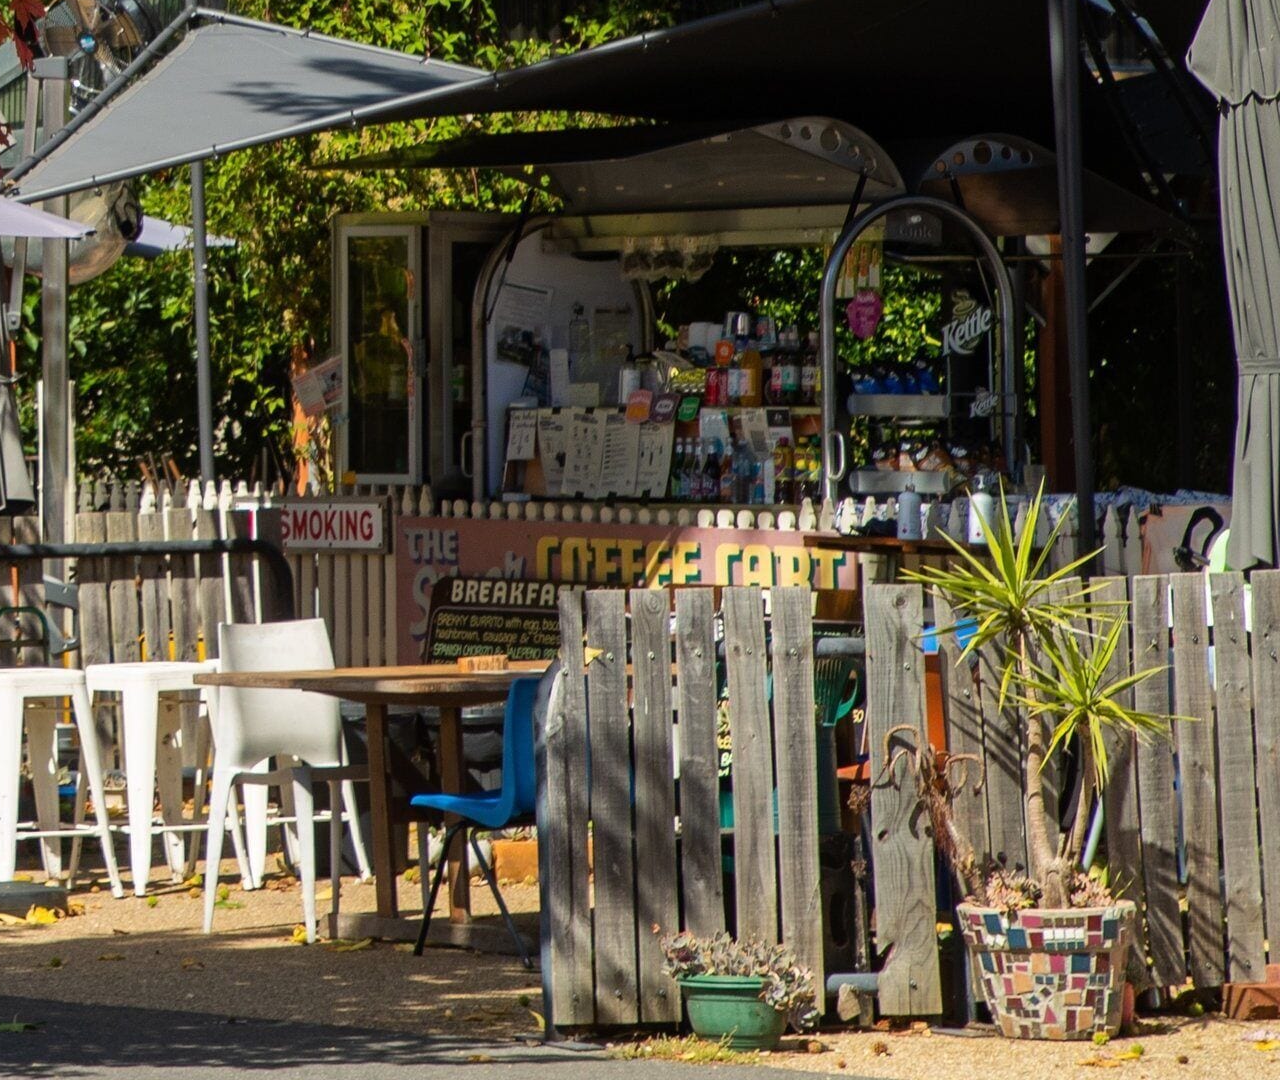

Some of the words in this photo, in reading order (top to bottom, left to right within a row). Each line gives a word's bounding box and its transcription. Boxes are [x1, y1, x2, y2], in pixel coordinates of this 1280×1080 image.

[942, 306, 992, 357] Kettle
[970, 395, 999, 418] Kettle
[281, 509, 373, 541] SMOKING
[405, 528, 459, 564] THE
[536, 536, 701, 589] COFFEE
[715, 542, 847, 590] CART
